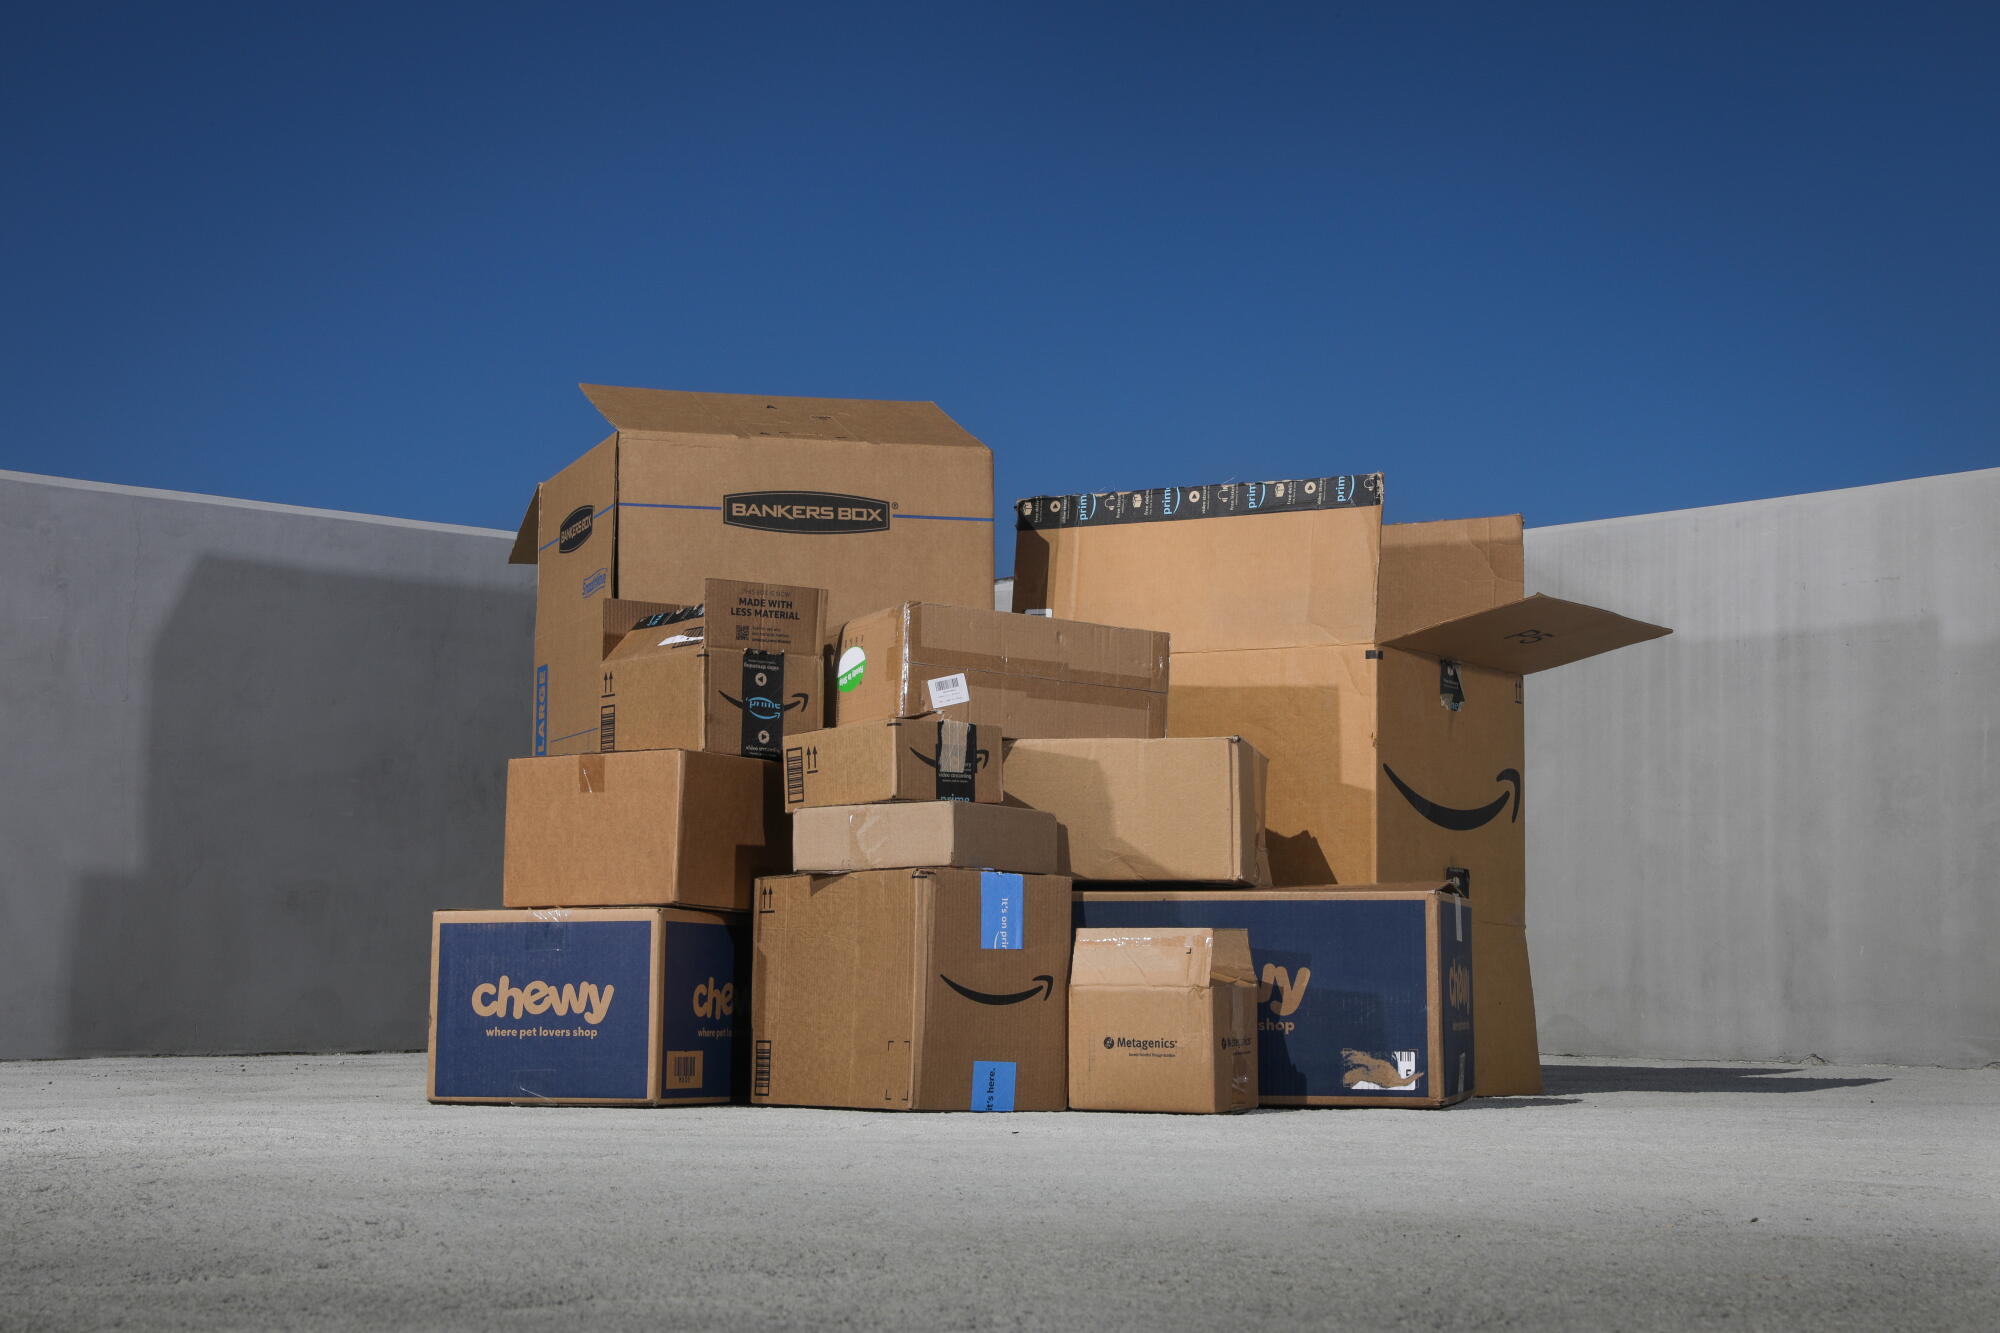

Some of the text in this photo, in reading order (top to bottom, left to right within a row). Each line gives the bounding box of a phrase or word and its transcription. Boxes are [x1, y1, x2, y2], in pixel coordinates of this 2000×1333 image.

[1162, 488, 1172, 515] prim
[732, 503, 883, 521] BANKERS BOX
[561, 514, 592, 543] BANKERS BOX
[738, 597, 793, 609] MADE WITH
[730, 607, 800, 620] LESS MATERIAL
[1001, 916, 1007, 928] on
[472, 975, 615, 1024] chewy
[486, 1026, 598, 1039] where pet lovers shop
[697, 1027, 715, 1038] where
[1259, 1018, 1295, 1035] shop
[1117, 1037, 1176, 1050] Metagenics
[987, 1068, 996, 1093] here.
